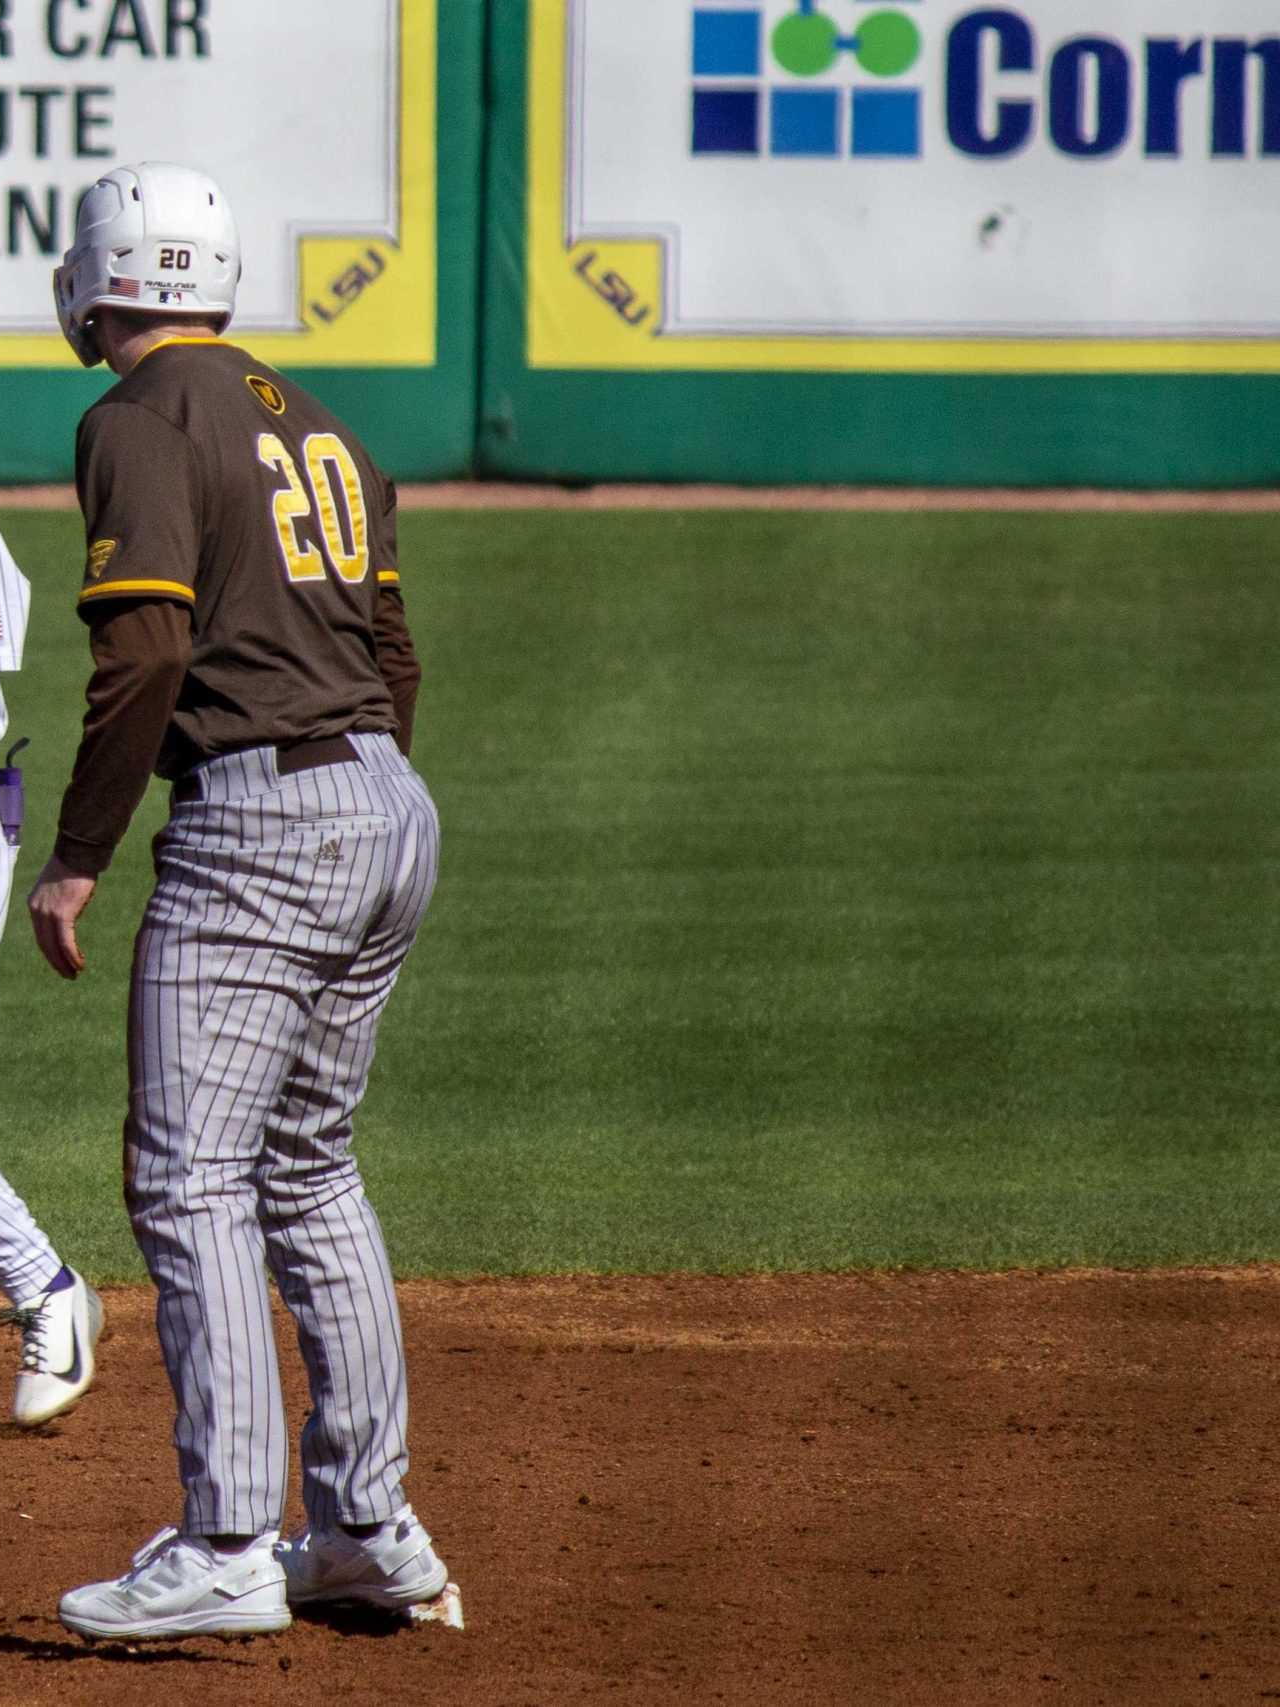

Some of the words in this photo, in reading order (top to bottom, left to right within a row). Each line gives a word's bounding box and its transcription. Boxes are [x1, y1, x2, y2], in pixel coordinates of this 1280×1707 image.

[46, 0, 211, 59] CAR
[160, 249, 191, 270] 20
[311, 248, 387, 323] LSU
[574, 250, 650, 326] LSU
[257, 432, 370, 584] 20
